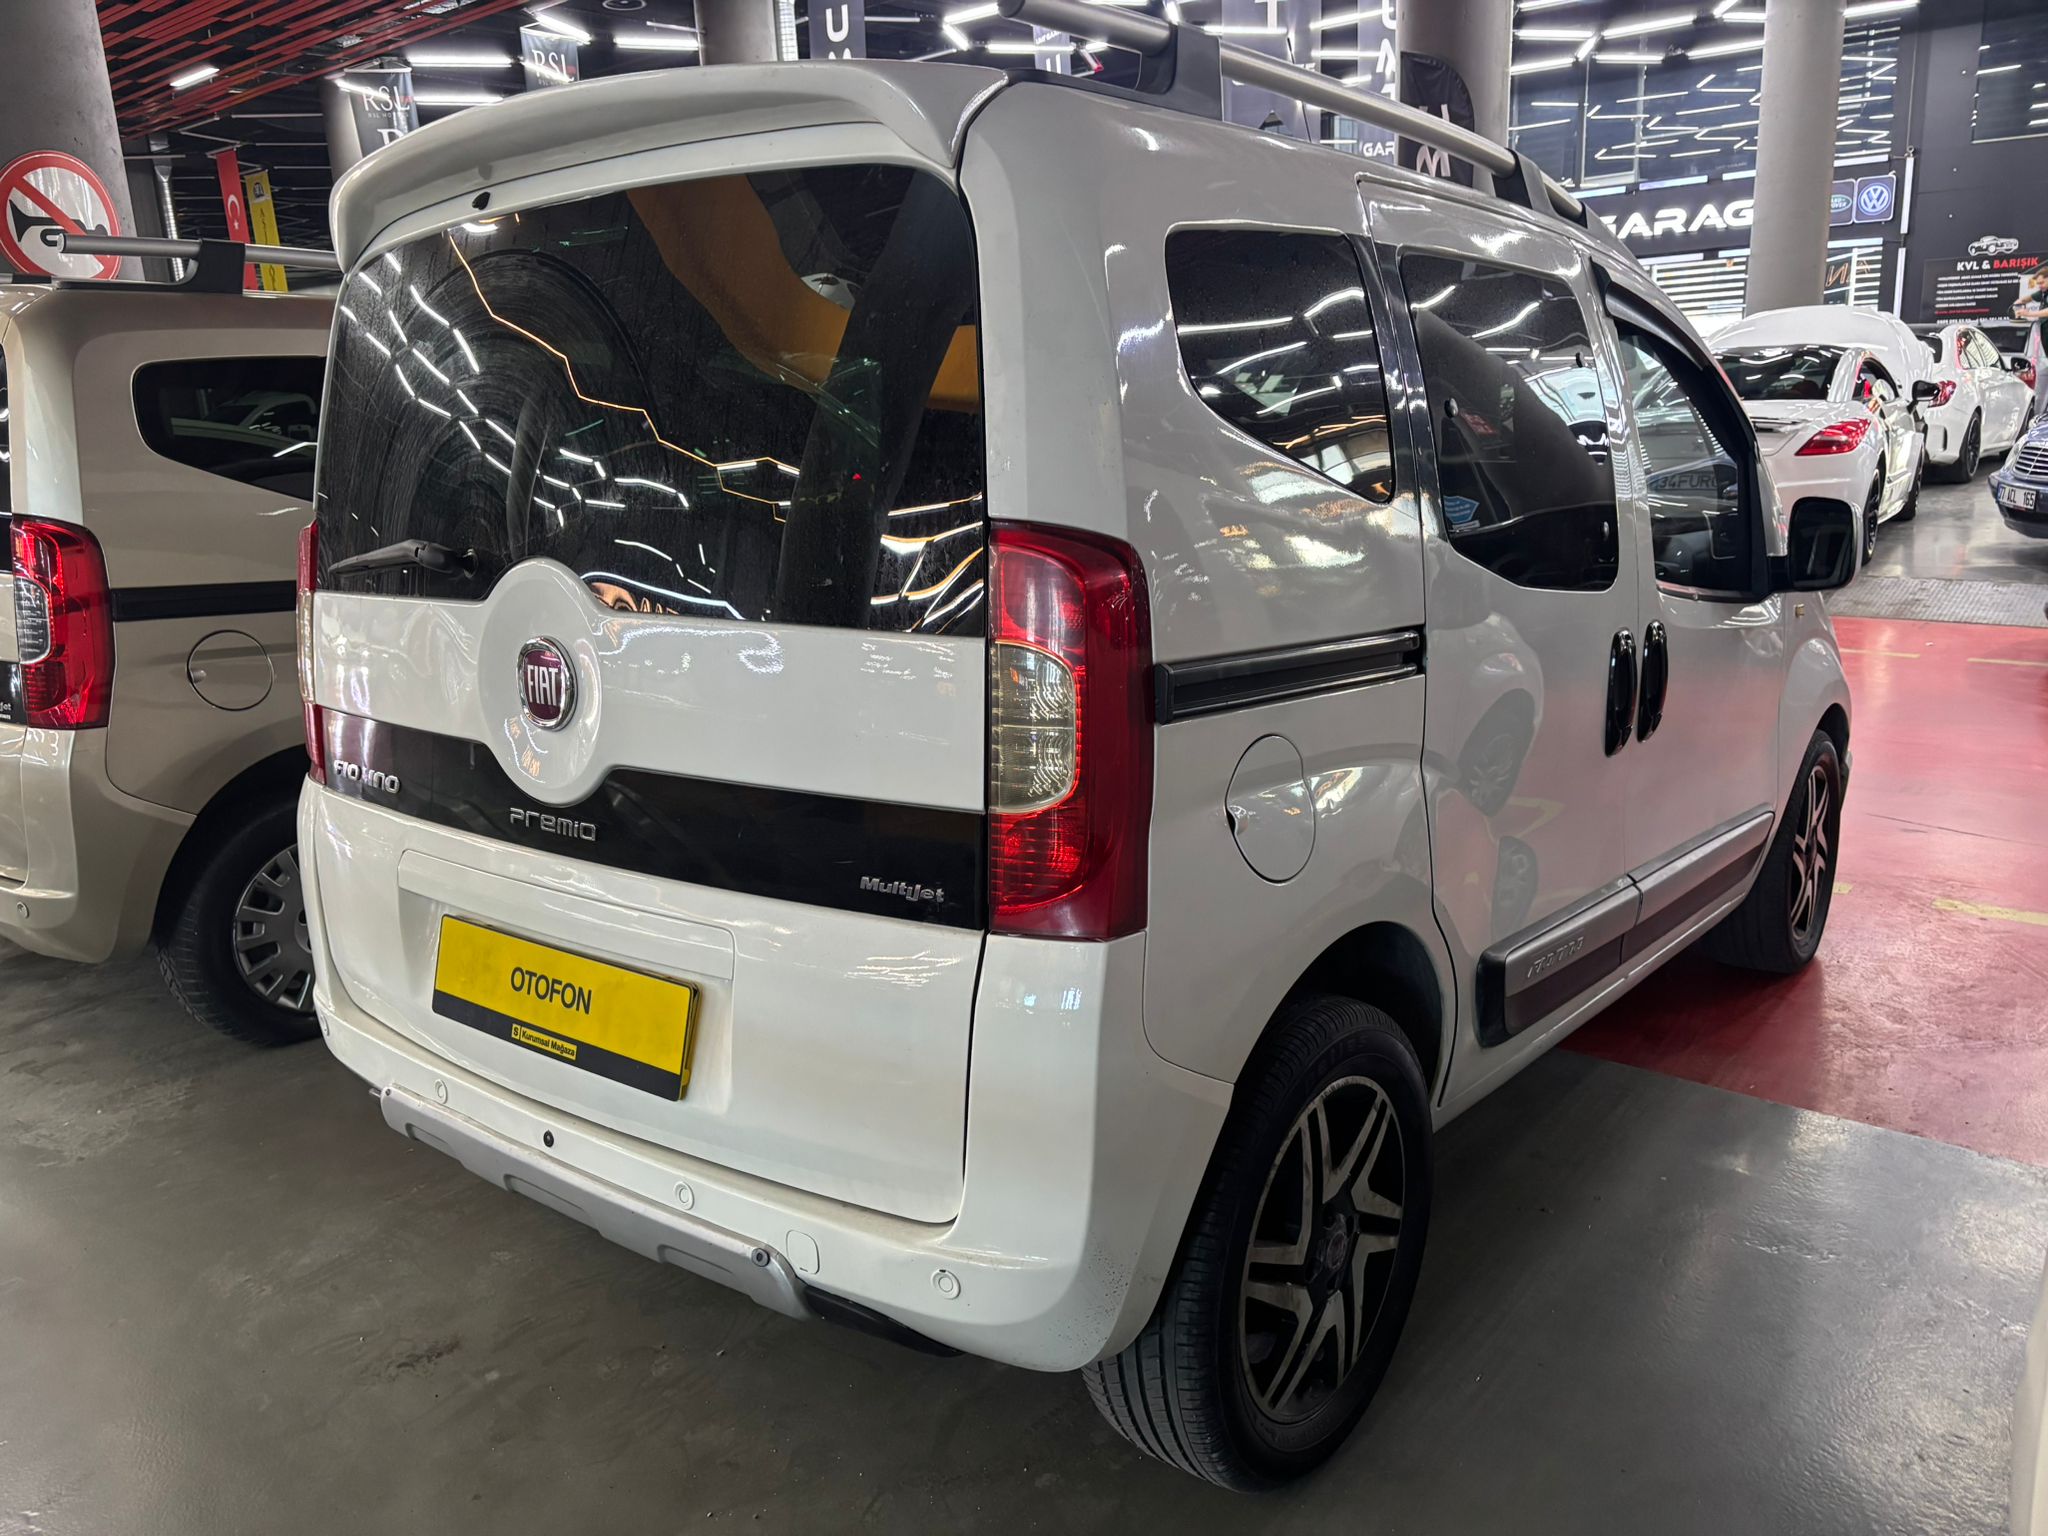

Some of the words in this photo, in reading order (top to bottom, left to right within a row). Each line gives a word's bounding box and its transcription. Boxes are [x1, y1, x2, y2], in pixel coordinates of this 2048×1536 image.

[1956, 261, 1980, 272] KVL
[1981, 260, 1991, 270] &
[1993, 256, 2039, 270] BARIŞIK
[527, 665, 560, 706] FIAT
[510, 967, 592, 1015] OTOFON
[521, 1030, 550, 1048] Kurumsal
[550, 1042, 575, 1057] Mağaza
